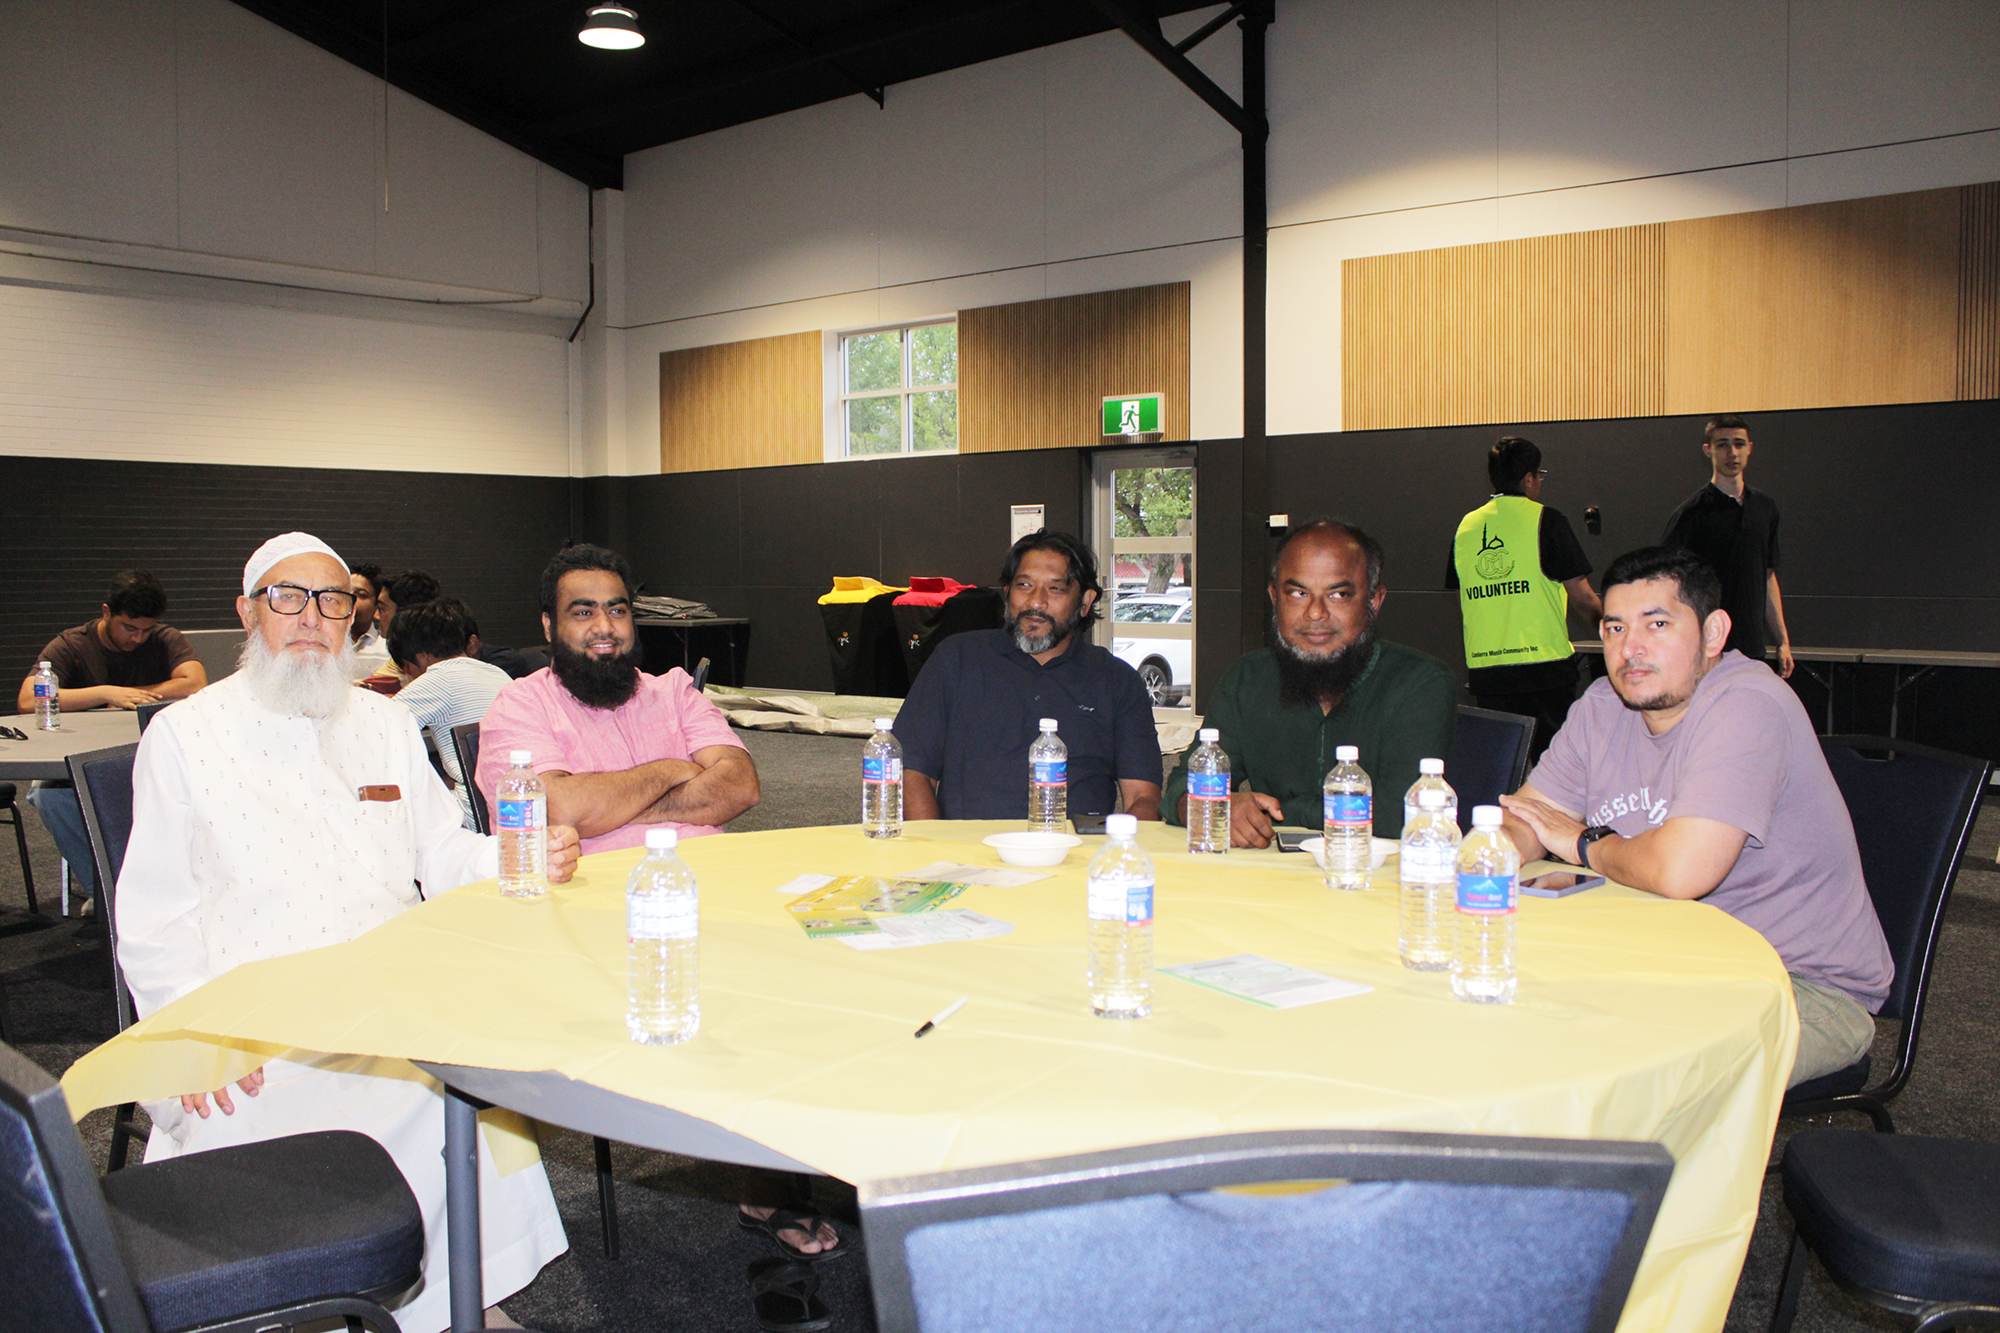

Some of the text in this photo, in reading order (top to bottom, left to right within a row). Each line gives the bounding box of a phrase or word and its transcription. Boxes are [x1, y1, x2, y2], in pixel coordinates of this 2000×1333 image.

[1466, 580, 1530, 600] VOLUNTEER
[1503, 646, 1530, 654] Community
[1587, 787, 1652, 828] ussell
